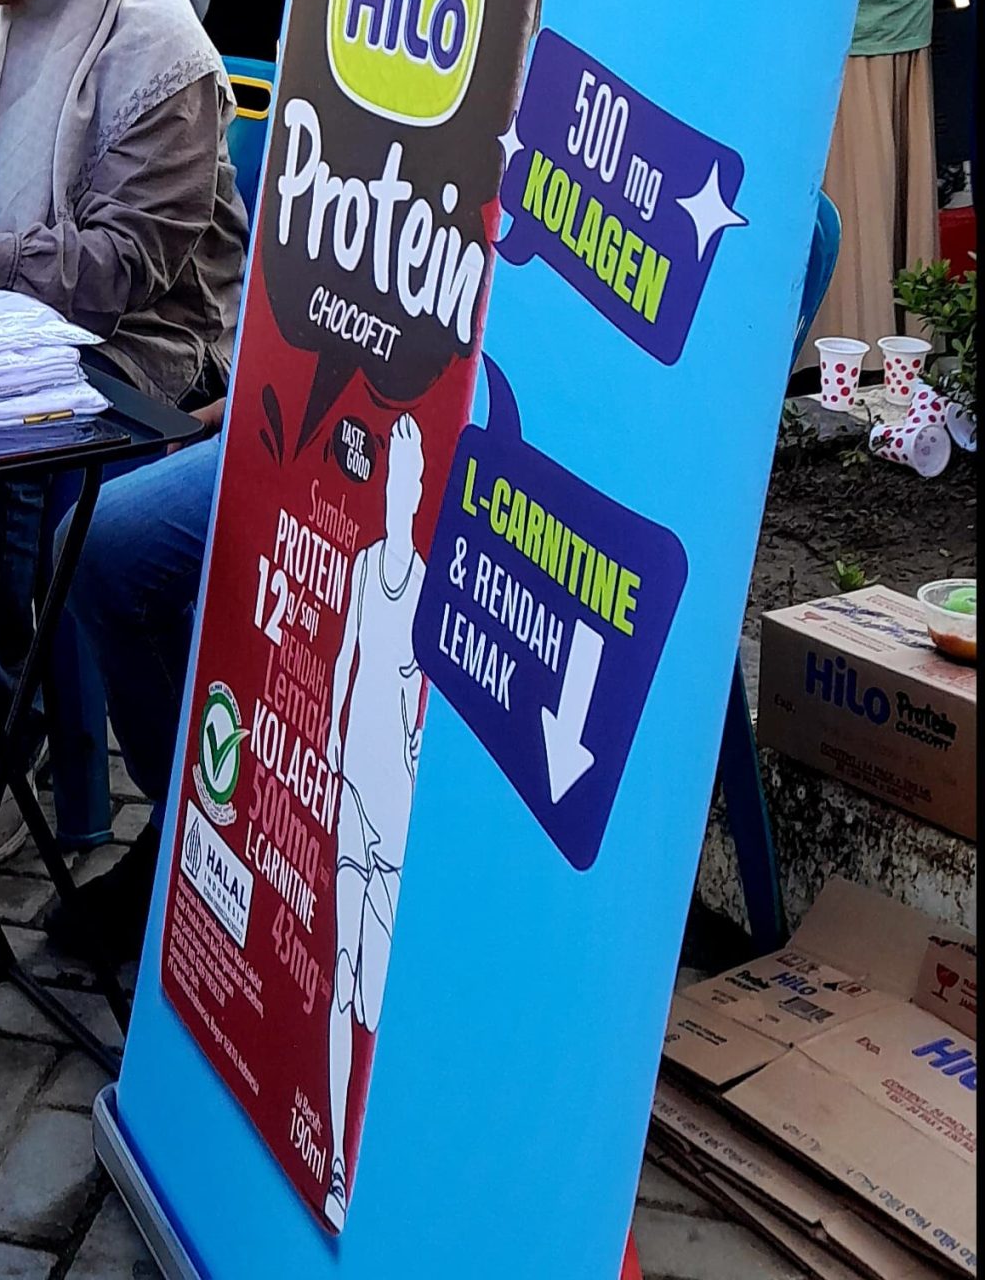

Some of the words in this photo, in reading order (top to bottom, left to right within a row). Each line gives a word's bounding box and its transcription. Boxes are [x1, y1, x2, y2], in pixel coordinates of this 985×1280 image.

[567, 69, 631, 185] 500
[623, 151, 664, 222] mg
[277, 98, 486, 345] Protein
[520, 149, 672, 326] KOLAGEN
[308, 285, 402, 363] CHOCOFIT
[342, 419, 366, 454] TASTE
[346, 449, 371, 482] GOOD
[273, 507, 349, 615] PROTEIN
[307, 478, 361, 553] Sumber
[461, 456, 642, 638] L-CARNITINE
[437, 603, 518, 713] LEMAK
[448, 536, 470, 592] &
[473, 552, 565, 673] RENDAH
[264, 643, 332, 756] Lemak
[279, 629, 328, 702] RENDAH
[805, 650, 892, 726] HiLo
[895, 690, 958, 740] Protein
[250, 697, 340, 836] KOLAGEN
[203, 871, 246, 928] INDONESIA
[205, 843, 247, 912] HALAL
[244, 820, 319, 935] L-CARNITINE
[271, 902, 320, 1015] 43mg
[289, 1106, 327, 1185] 190ml
